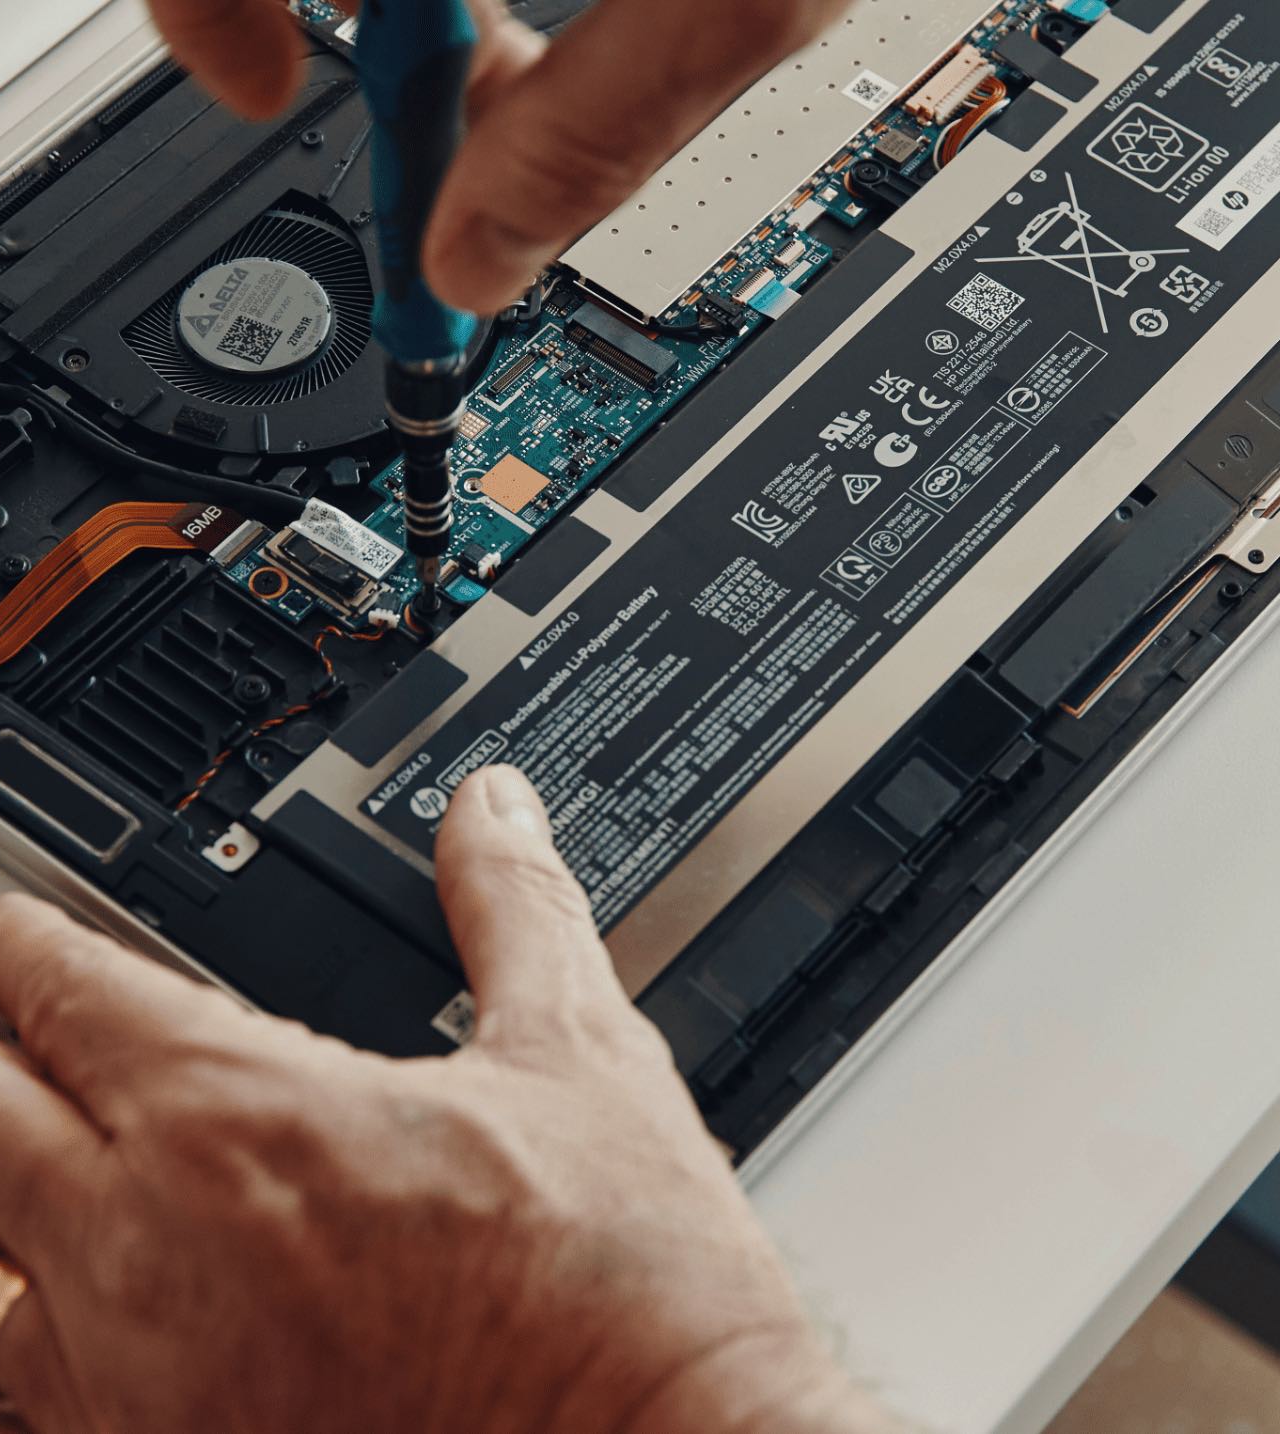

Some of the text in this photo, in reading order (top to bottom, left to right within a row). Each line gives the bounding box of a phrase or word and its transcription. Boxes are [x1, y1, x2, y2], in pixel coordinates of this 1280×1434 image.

[1104, 73, 1149, 111] M2.0X4.0
[1231, 61, 1279, 107] www.bis.gov.in
[1165, 145, 1229, 203] Li-ion 00
[1222, 189, 1248, 213] hp
[809, 249, 829, 265] BL
[933, 233, 977, 273] M2.0X4.0
[1140, 315, 1162, 332] 5
[685, 353, 720, 381] WWAN
[932, 331, 986, 379] TIS 2217-2548
[943, 317, 1019, 387] HP Inc (Thailand) Ltd.
[953, 318, 1032, 391] Rechargeable Li-Polymer Battery
[868, 369, 900, 394] UK
[884, 378, 914, 402] CA
[901, 386, 951, 426] CE
[935, 399, 963, 425] 6304mAh)
[858, 433, 876, 449] SCQ
[793, 452, 819, 475] 6304mAh
[800, 464, 832, 493] Technology
[924, 466, 954, 492] CQC
[791, 494, 813, 514] (Chong
[823, 471, 836, 482] Inc.
[901, 502, 911, 512] HP
[948, 491, 958, 501] HP
[182, 505, 223, 540] 16MB
[458, 521, 482, 543] RTC
[883, 444, 1060, 619] Please shut down and unplug the battery cable before replacing!
[697, 591, 723, 615] STORE
[720, 559, 757, 593] BETWEEN
[735, 595, 750, 607] TO
[744, 600, 759, 612] TO
[738, 588, 790, 635] SCQ-CHA-ATL
[529, 611, 579, 657] M2.0X4.0
[410, 786, 449, 820] hp
[500, 668, 570, 733] Rechargeable
[566, 618, 621, 669] Li-Polymer
[617, 586, 657, 620] Battery
[564, 698, 612, 744] PROCESSED
[619, 667, 646, 690] CHINA
[378, 753, 430, 800] M2.0X4.0
[550, 781, 599, 835] NING!
[590, 818, 678, 904] RTISSEMENT!
